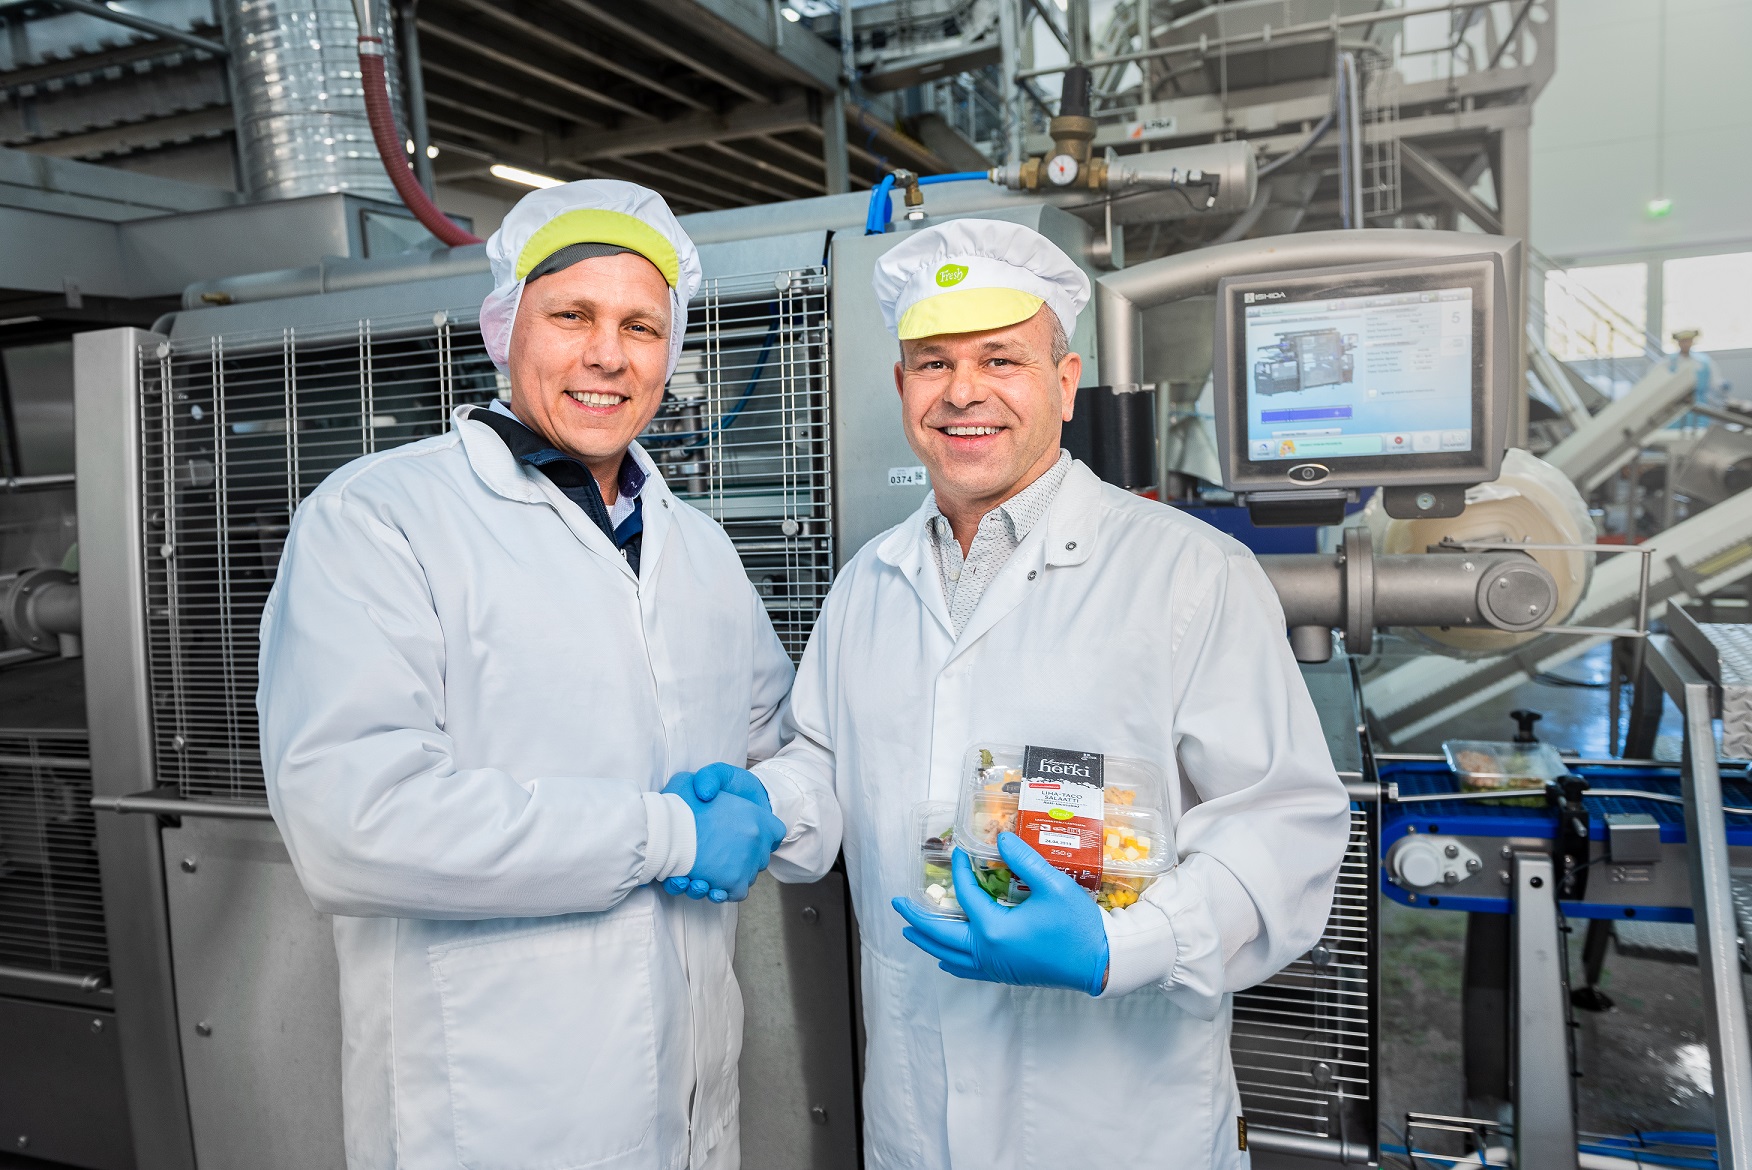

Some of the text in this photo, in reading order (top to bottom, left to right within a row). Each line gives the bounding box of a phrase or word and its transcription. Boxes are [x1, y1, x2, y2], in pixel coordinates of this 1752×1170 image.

[940, 268, 963, 282] Fresh
[1255, 292, 1286, 300] ISHIDA
[1451, 311, 1460, 324] 5
[890, 475, 912, 484] 0374
[1041, 790, 1083, 799] LIHA-TACO
[1044, 795, 1079, 803] SALAATTI
[1051, 848, 1065, 856] 250
